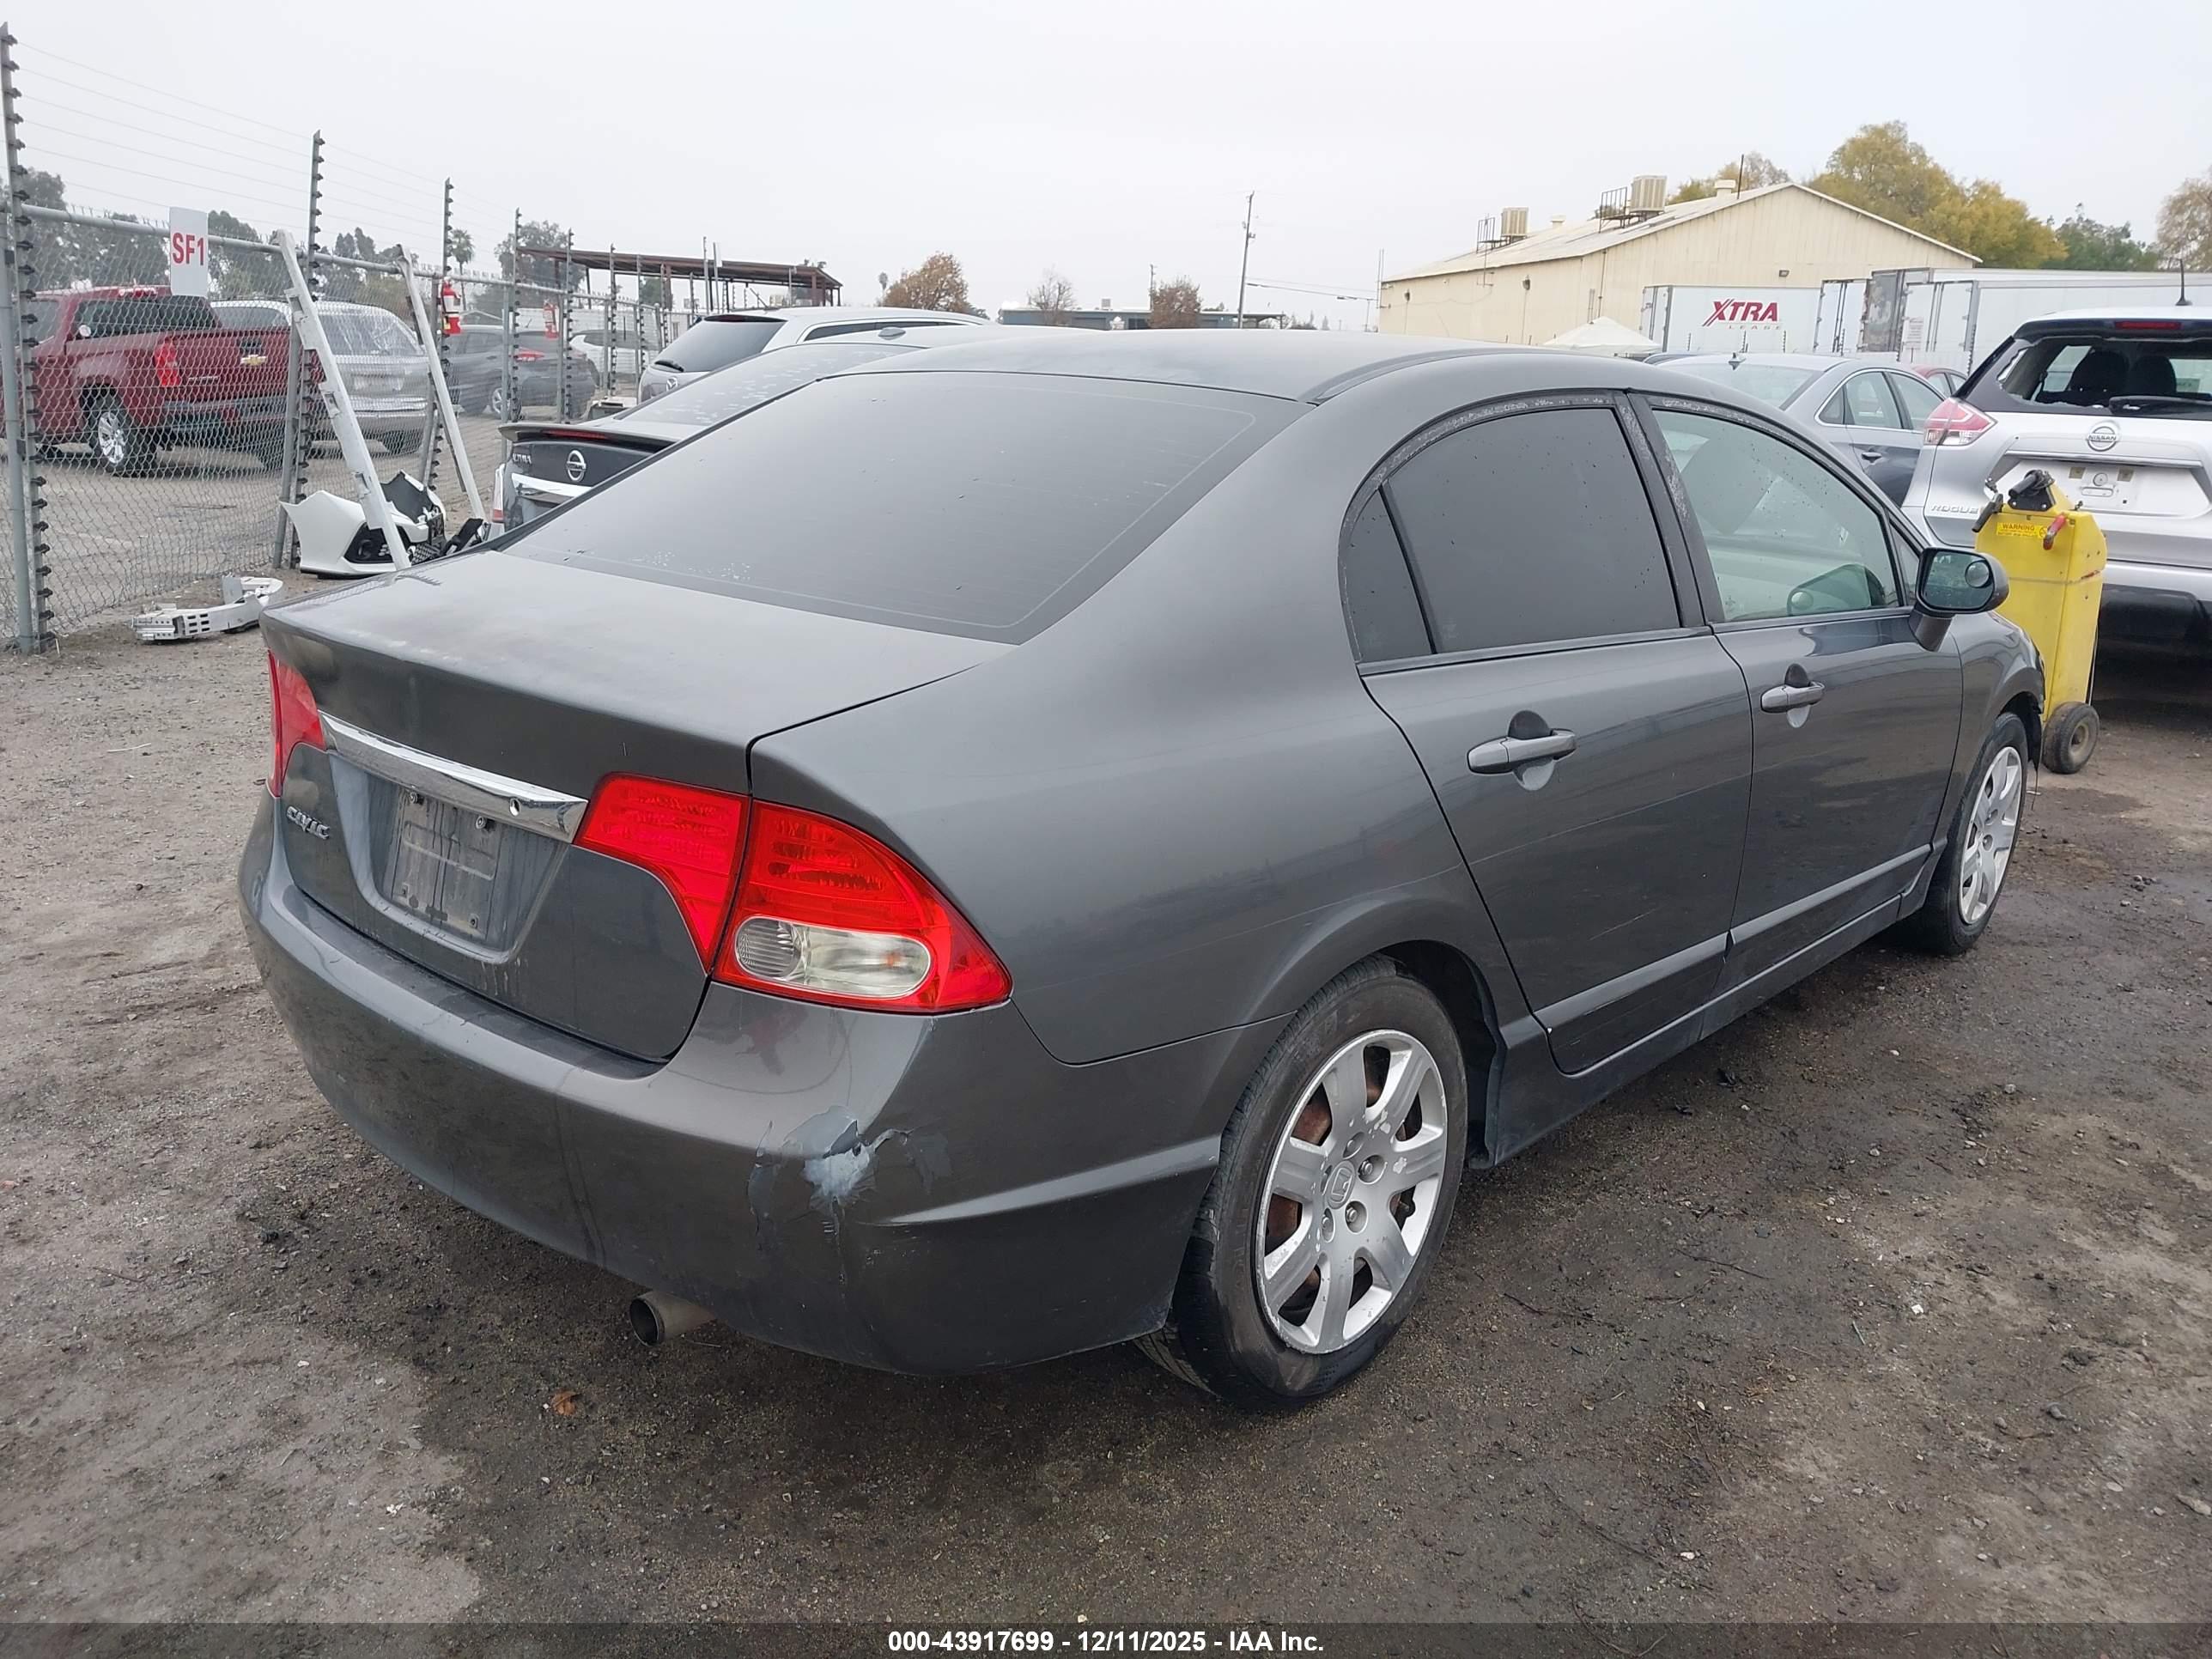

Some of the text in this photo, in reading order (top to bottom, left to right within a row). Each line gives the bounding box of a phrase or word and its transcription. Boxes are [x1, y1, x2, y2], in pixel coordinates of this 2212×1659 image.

[173, 232, 204, 266] SF1
[1702, 298, 1778, 327] XTRA
[1931, 505, 1978, 514] ROGUE
[2002, 523, 2035, 532] WARNING
[287, 805, 330, 840] CIVIC
